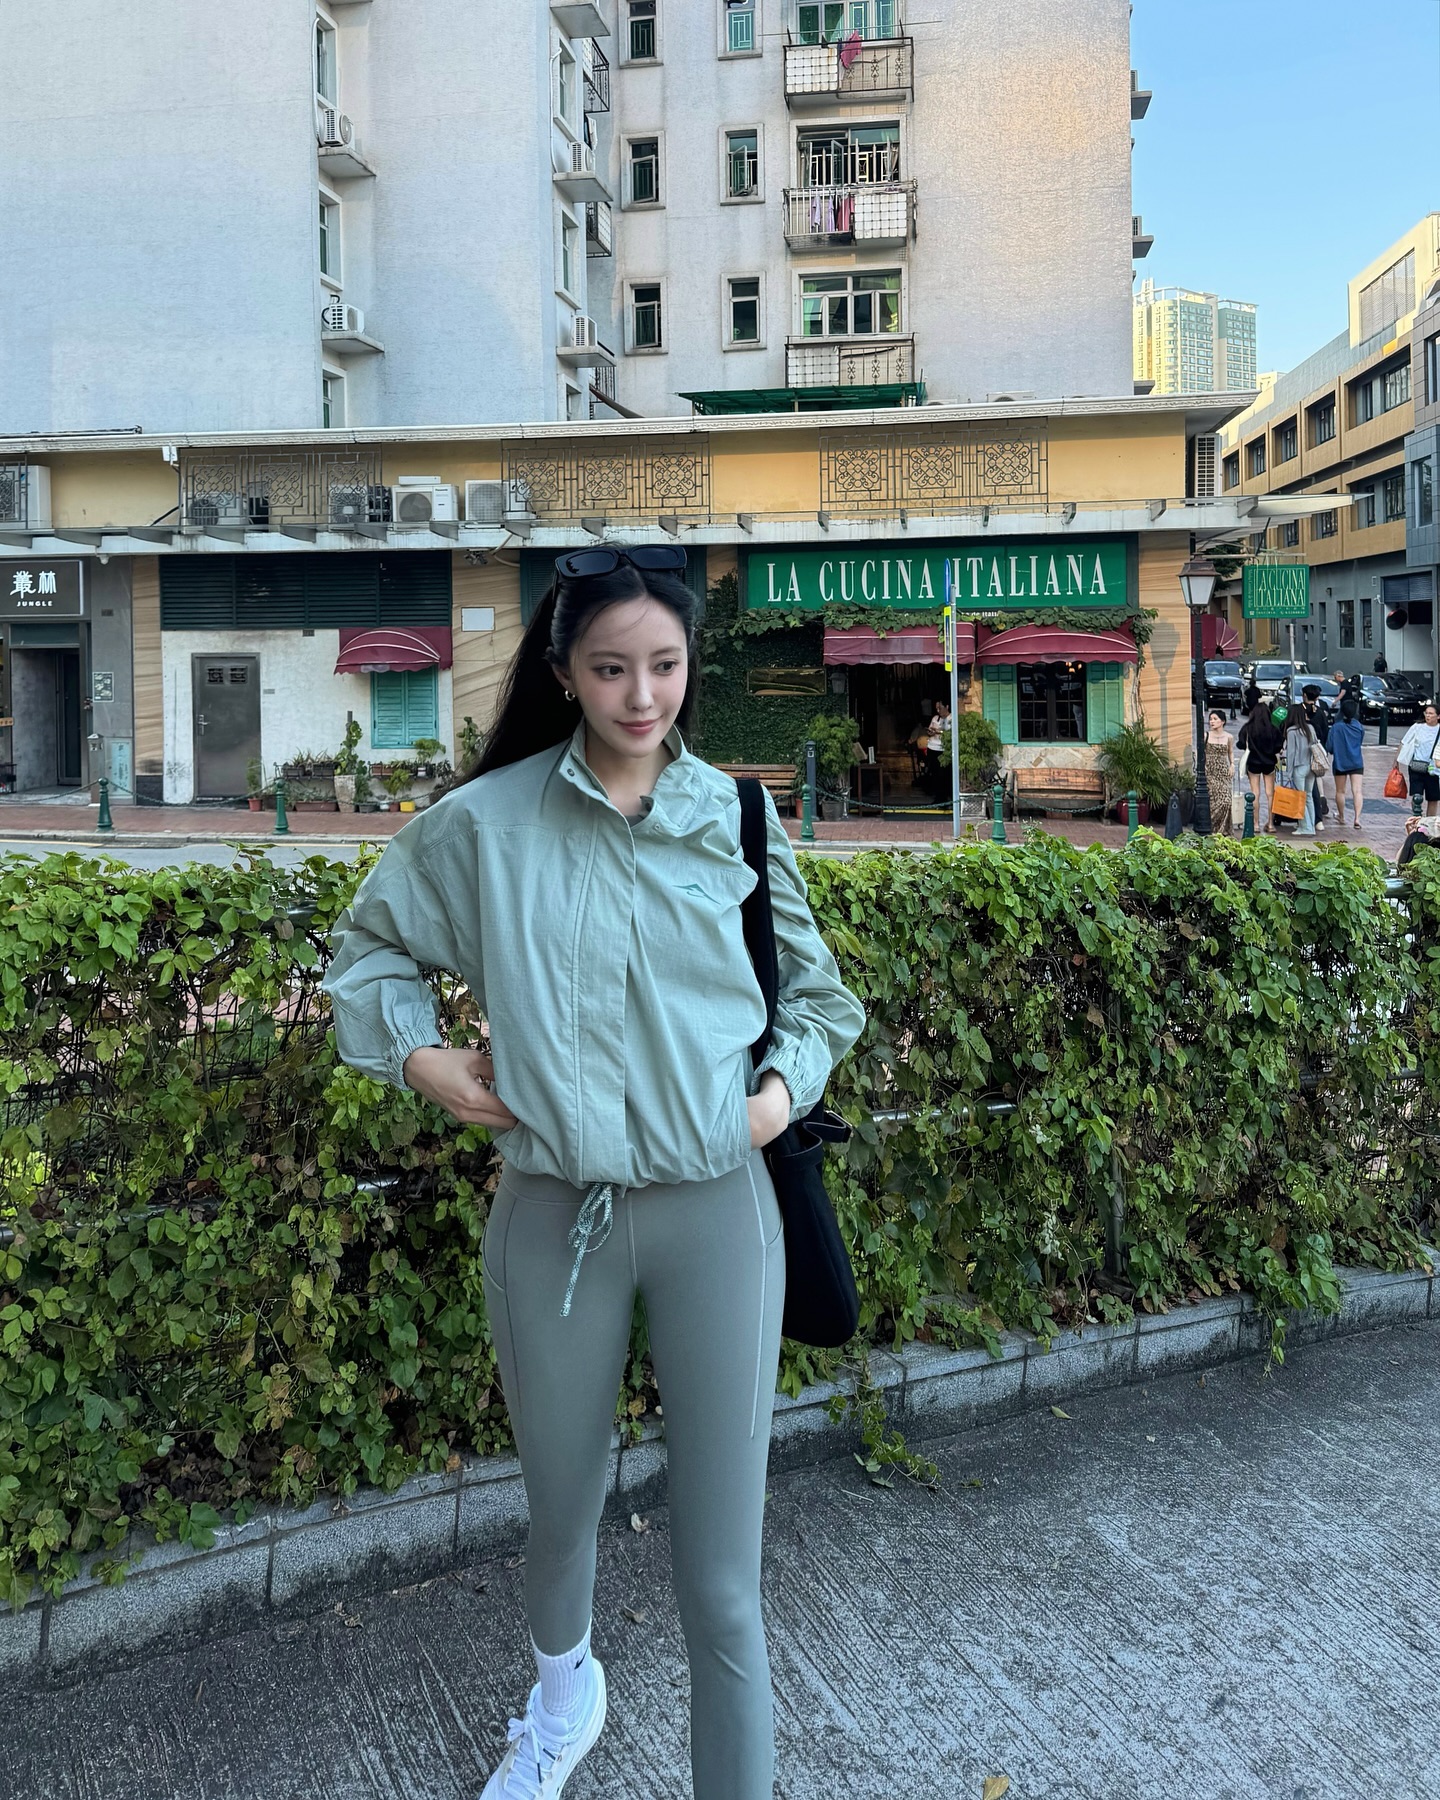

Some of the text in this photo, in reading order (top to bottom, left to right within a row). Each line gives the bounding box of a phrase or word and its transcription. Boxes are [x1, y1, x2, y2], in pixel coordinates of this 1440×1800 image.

[10, 570, 56, 599] 叢林
[767, 553, 1107, 602] LA CUCINA ITALIANA
[1268, 569, 1304, 590] CUCINA
